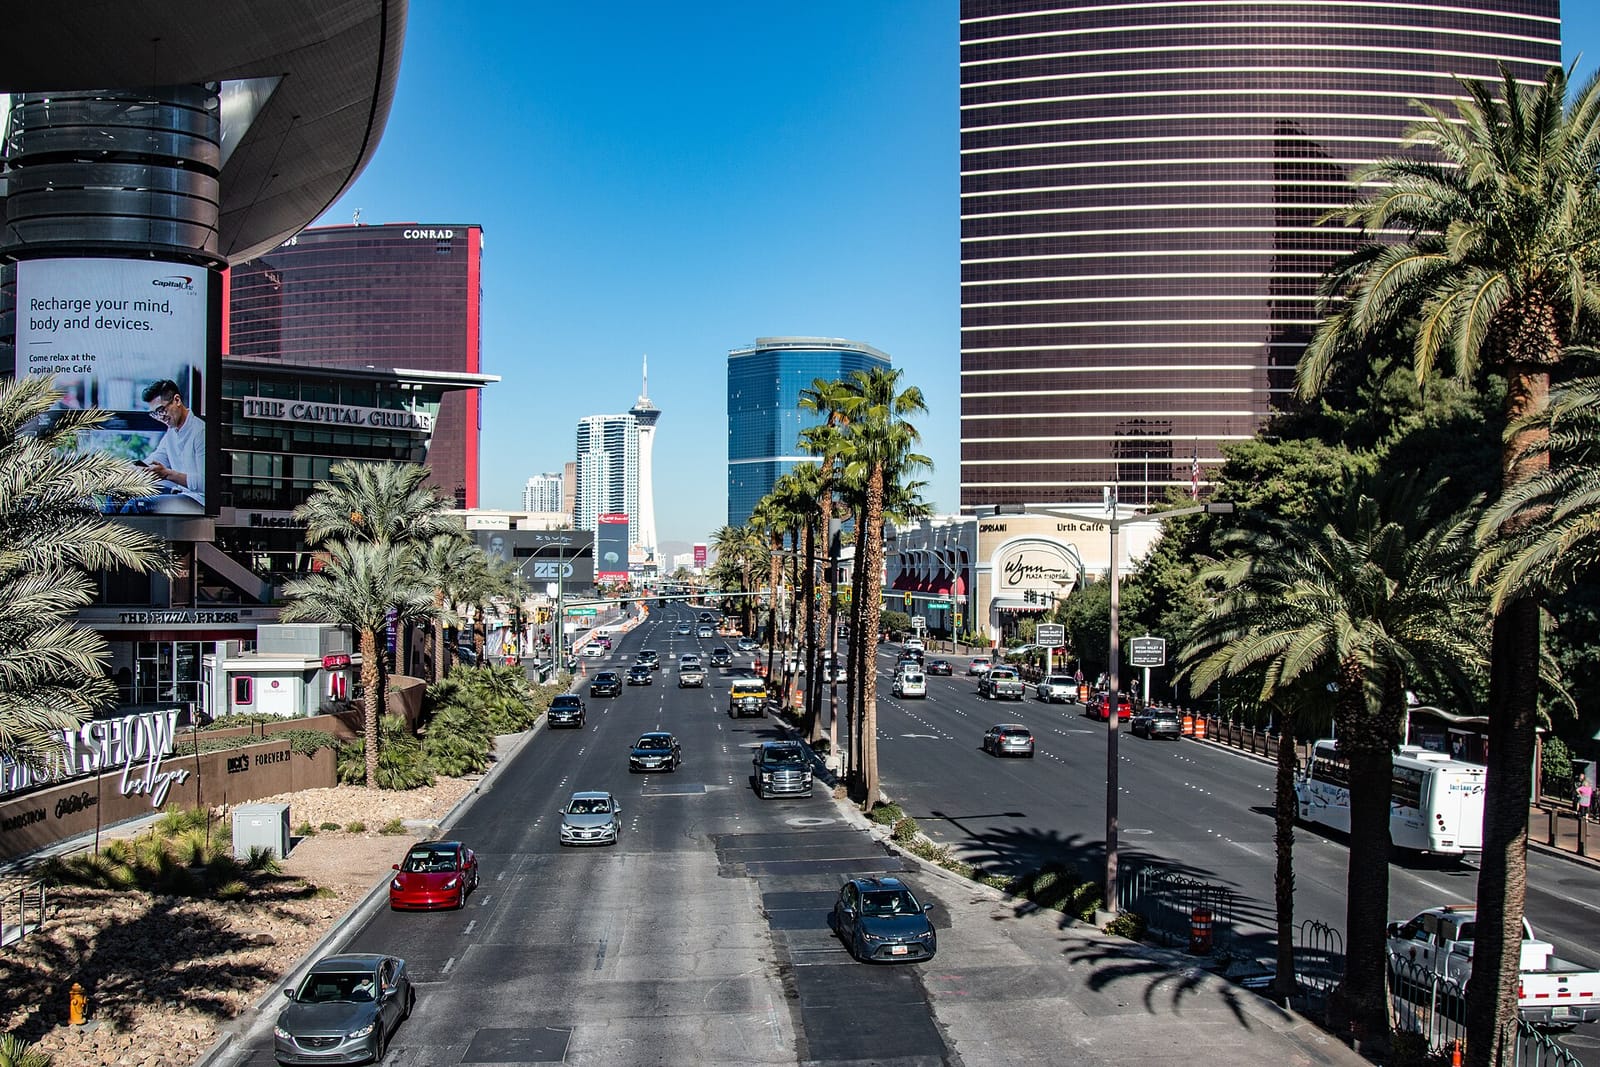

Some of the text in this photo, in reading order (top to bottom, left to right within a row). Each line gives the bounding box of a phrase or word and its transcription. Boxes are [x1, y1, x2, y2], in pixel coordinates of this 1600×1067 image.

[403, 229, 454, 239] CONRAD
[30, 296, 174, 315] Recharge your mind,
[30, 315, 154, 333] body and devices.
[28, 353, 96, 362] Come relax at the
[28, 364, 92, 375] Capital One Café
[248, 399, 431, 430] THE CAPITAL GRILLE
[979, 524, 1007, 533] CIPRIANI
[1057, 523, 1077, 532] Urth
[1004, 554, 1062, 586] Wynn
[119, 611, 239, 624] THE PIZZA PRESS
[82, 708, 182, 773] SHOW
[255, 750, 291, 766] FOREVER 21
[146, 747, 191, 808] Vegas
